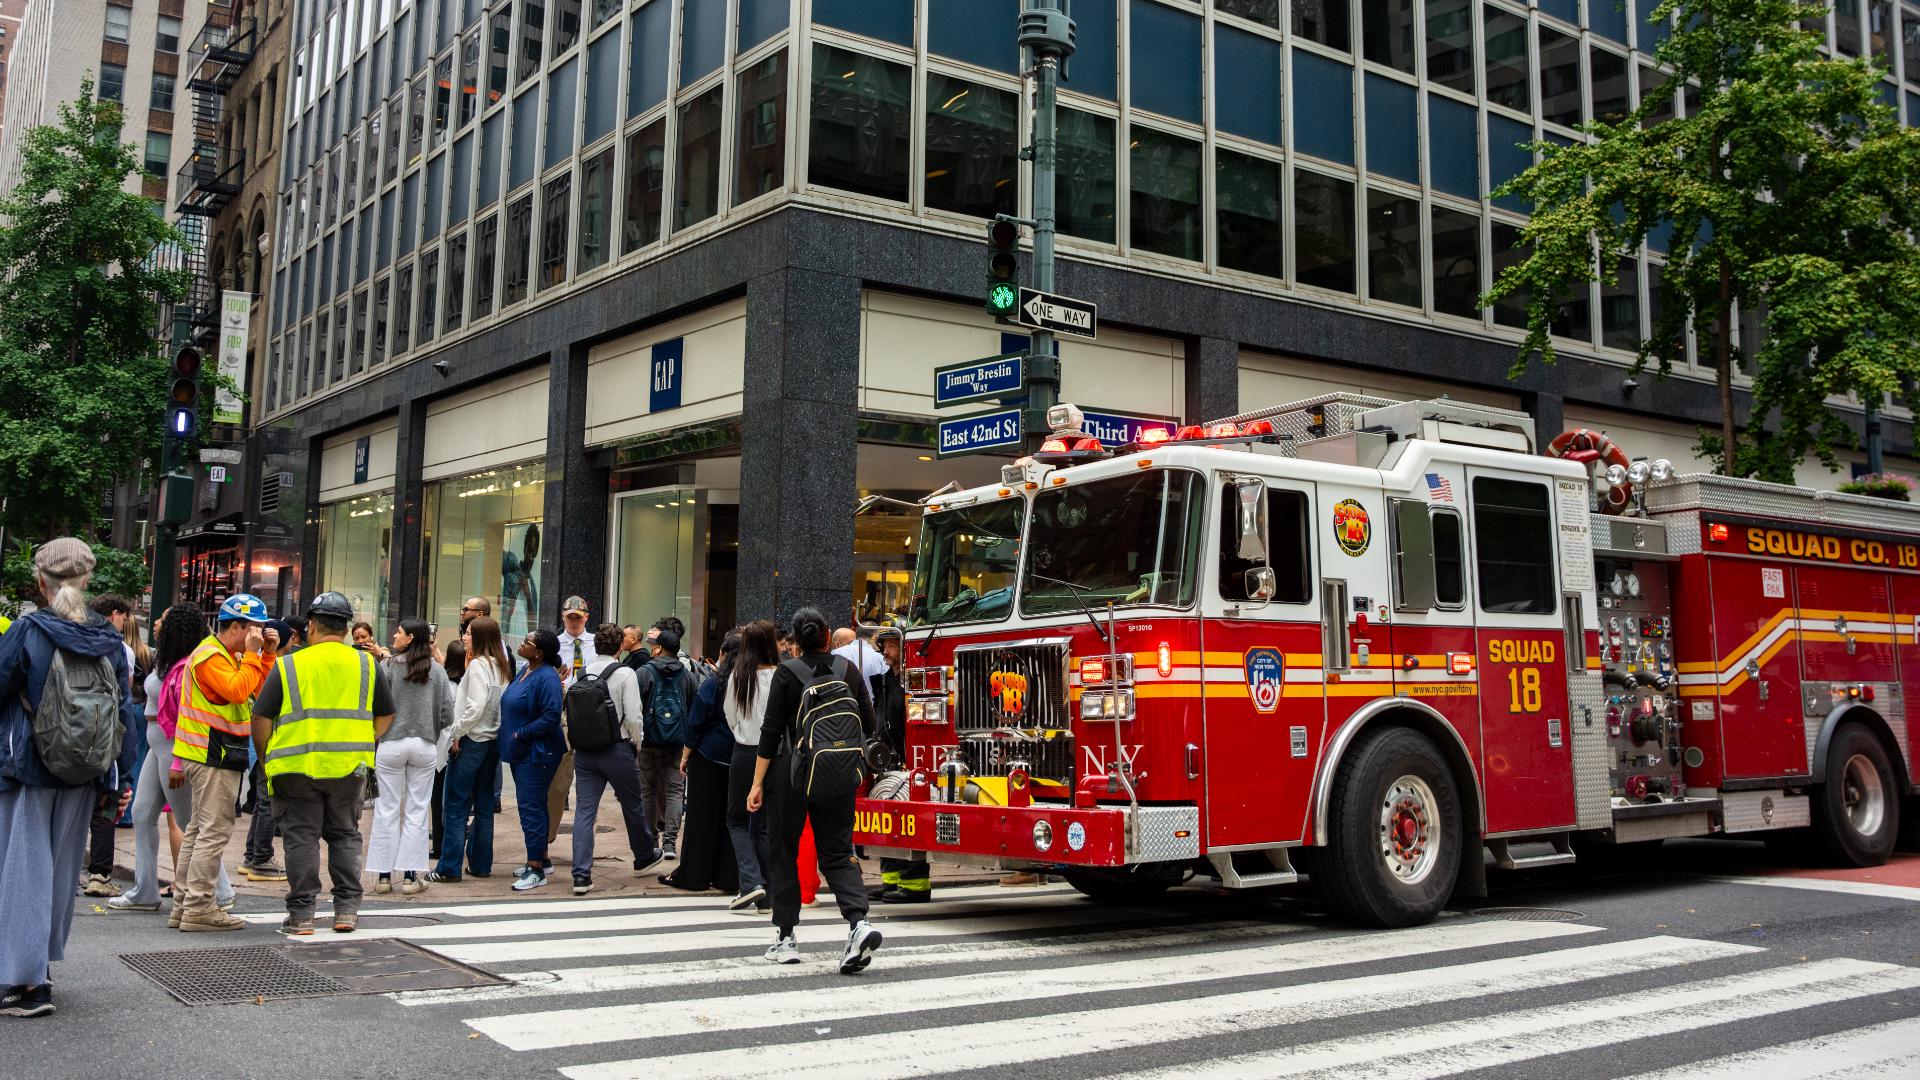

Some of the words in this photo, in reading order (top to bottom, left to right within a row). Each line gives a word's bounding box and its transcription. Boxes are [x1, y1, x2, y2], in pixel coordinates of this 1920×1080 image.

[225, 298, 247, 313] FOOD
[1031, 302, 1054, 319] ONE
[1063, 308, 1087, 326] WAY
[226, 335, 242, 349] FOR
[654, 358, 675, 393] GAP
[945, 373, 976, 389] Jimmy
[977, 363, 1012, 382] Breslin
[972, 383, 988, 393] Way
[942, 428, 969, 447] East
[970, 420, 1001, 443] 42nd
[1003, 418, 1017, 438] St
[1082, 419, 1129, 442] Third
[212, 468, 224, 480] EAT
[1345, 519, 1365, 542] 18
[1747, 528, 1841, 560] SQUAD
[1851, 539, 1890, 565] CO.
[1896, 544, 1918, 567] 18
[1763, 570, 1782, 582] FAST
[1767, 583, 1781, 594] PAK
[1489, 639, 1555, 663] SQUAD
[1003, 687, 1022, 713] 18
[1412, 686, 1473, 695] www.nyc.gov/fdny
[1508, 667, 1542, 713] 18
[900, 813, 916, 836] 18
